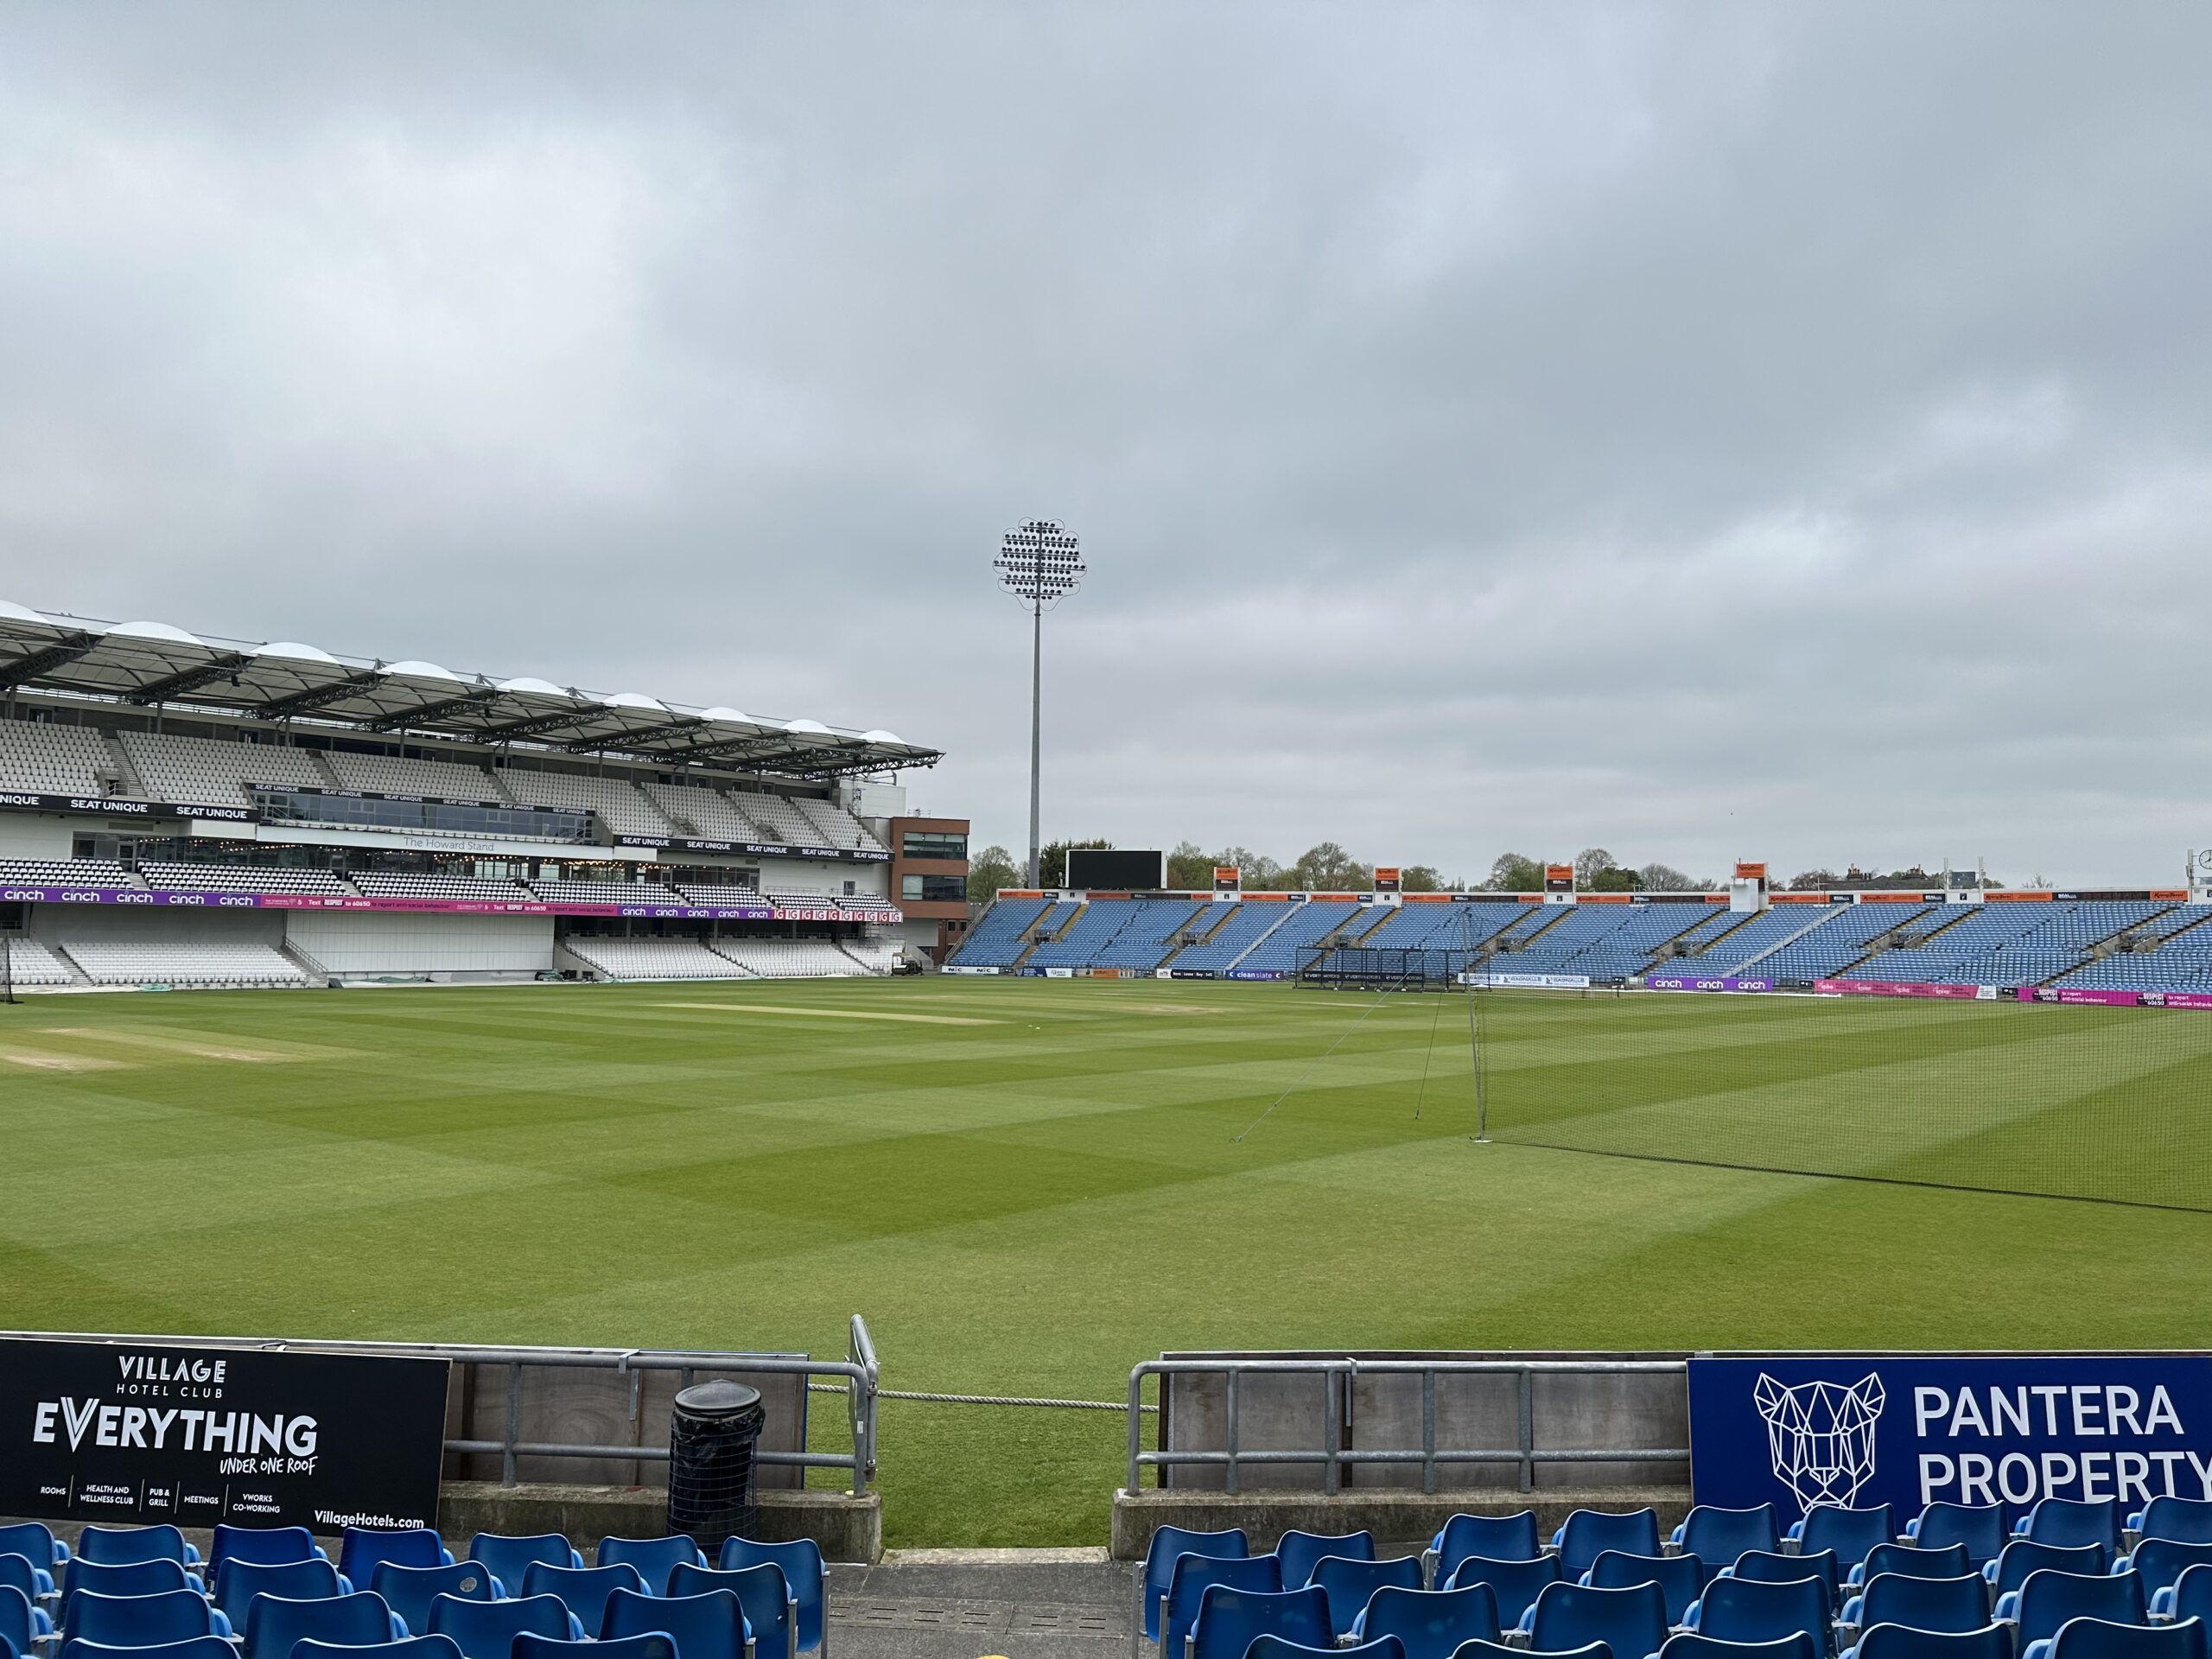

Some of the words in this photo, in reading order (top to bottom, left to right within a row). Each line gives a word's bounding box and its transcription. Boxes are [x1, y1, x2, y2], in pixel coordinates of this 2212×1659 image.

[70, 799, 101, 810] SEAT
[103, 802, 148, 813] UNIQUE
[176, 806, 205, 816] SEAT
[206, 809, 248, 818] UNIQUE
[404, 837, 423, 848] The
[427, 839, 465, 850] Howard
[467, 841, 494, 852] Stand
[4, 888, 44, 900] cinch
[61, 890, 100, 901] cinch
[117, 892, 153, 903] cinch
[169, 893, 205, 905] cinch
[219, 894, 253, 906] cinch
[622, 907, 645, 916] cinch
[656, 908, 678, 917] cinch
[687, 908, 709, 918] cinch
[718, 909, 739, 918] cinch
[747, 910, 768, 918] cinch
[1655, 977, 1682, 988] cinch
[1696, 979, 1724, 988] cinch
[1738, 979, 1765, 989] cinch
[118, 1356, 226, 1382] VILLAGE
[117, 1383, 169, 1396] HOTEL
[181, 1387, 223, 1399] CLUB
[1914, 1385, 2184, 1437] PANTERA
[33, 1396, 318, 1457] EVERYTHING
[219, 1457, 257, 1475] UNDER
[1918, 1451, 2212, 1505] PROPERTY
[41, 1486, 67, 1495] ROOMS
[86, 1484, 112, 1494] HEALTH
[149, 1488, 163, 1497] PUB
[79, 1494, 114, 1504] WELLNESS
[115, 1496, 134, 1505] CLUB
[149, 1498, 168, 1507] GRILL
[183, 1496, 219, 1505] MEETINGS
[243, 1493, 273, 1503] VWORKS
[232, 1503, 280, 1514] CO-WORKING
[314, 1510, 424, 1529] VillageHotels.com
